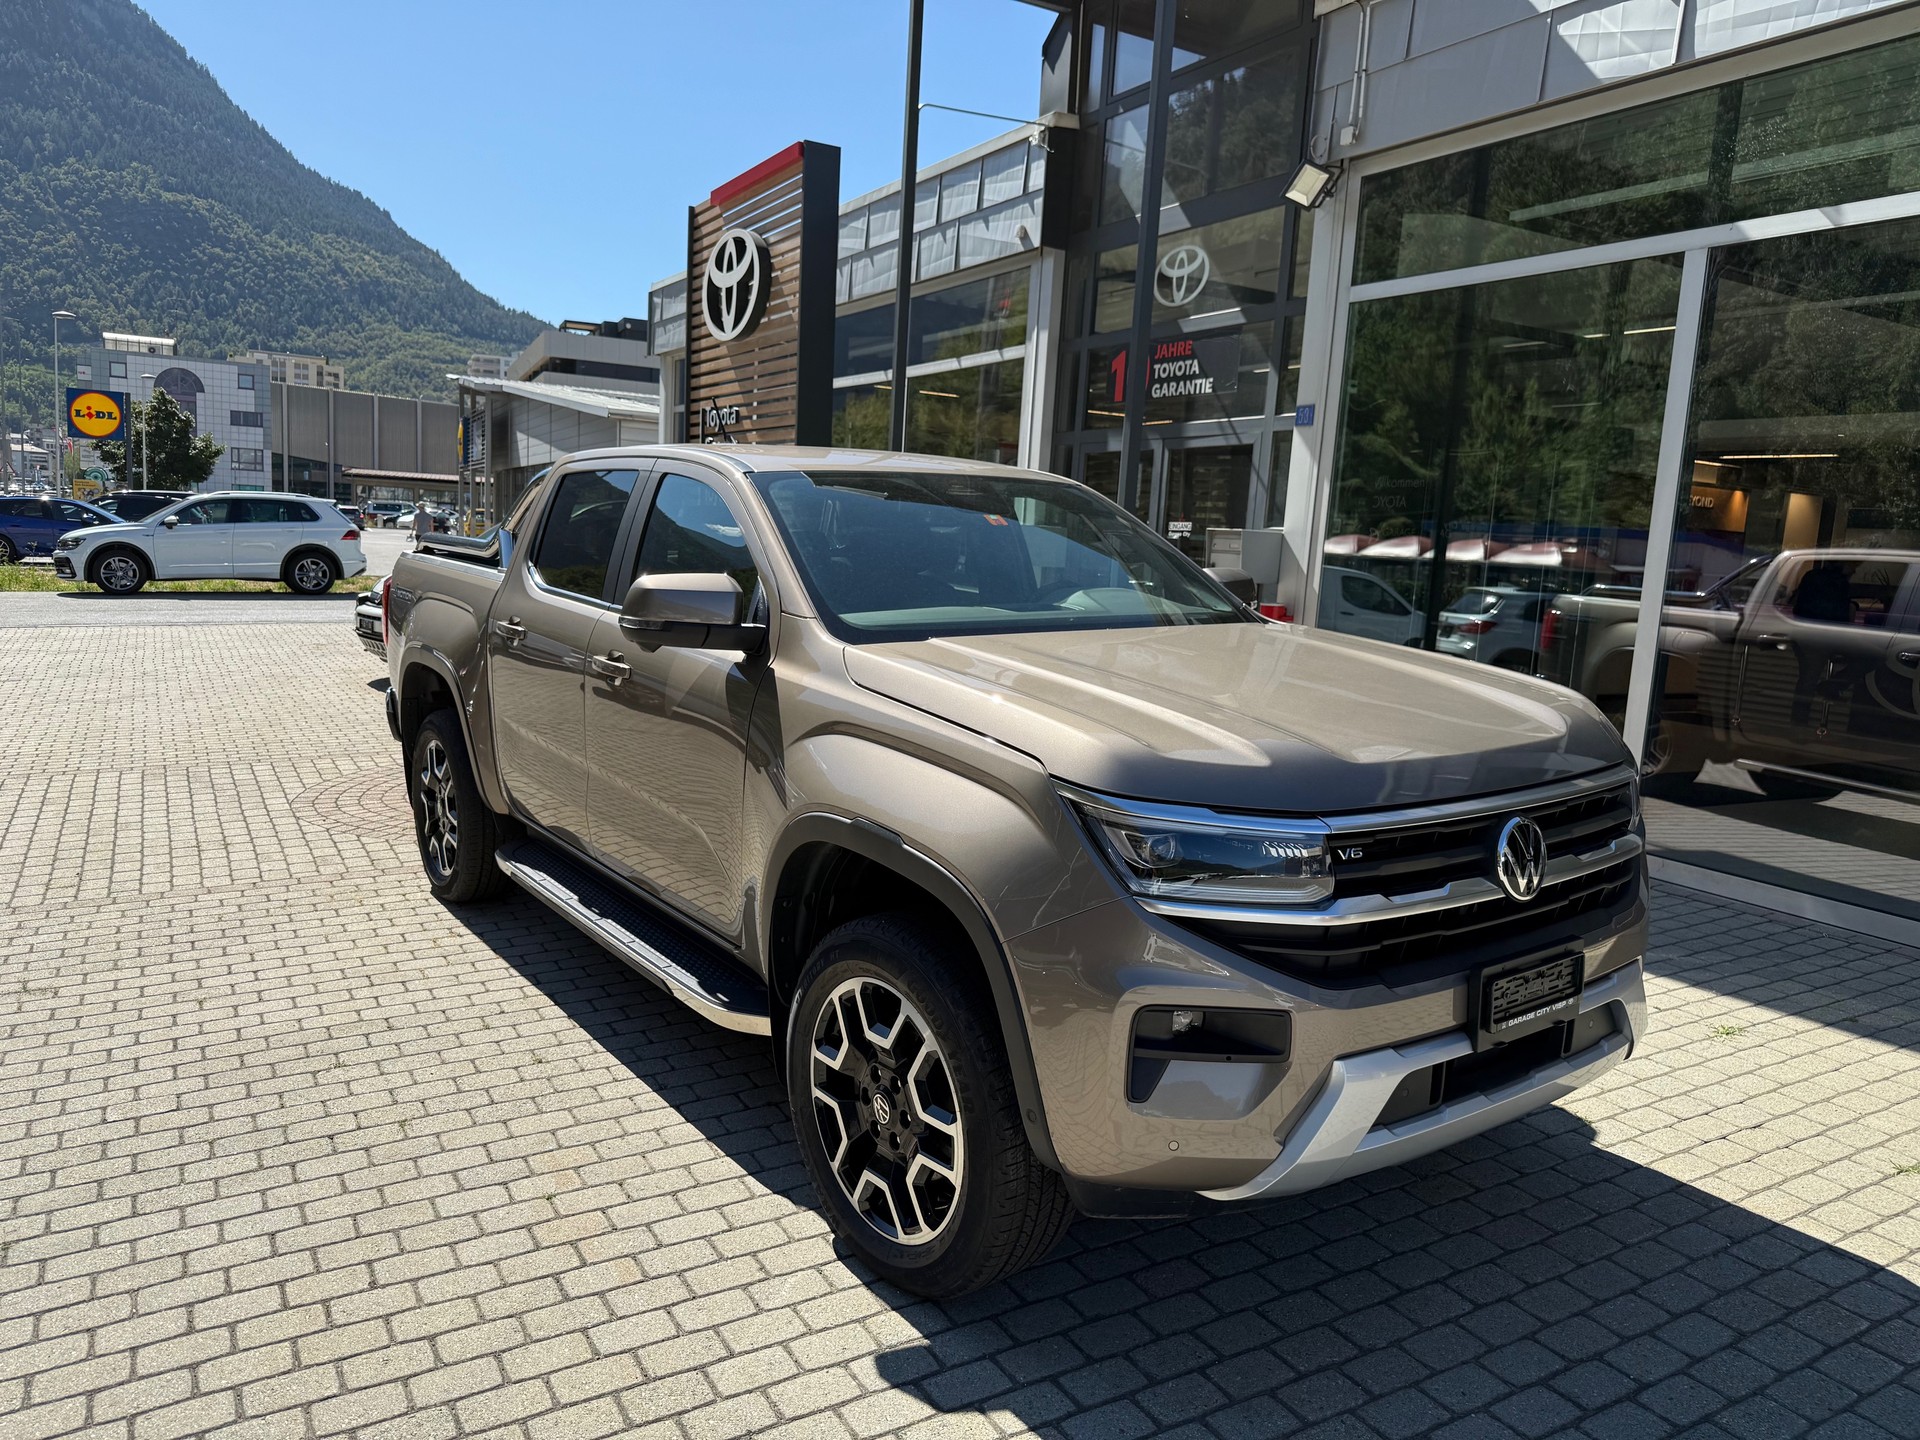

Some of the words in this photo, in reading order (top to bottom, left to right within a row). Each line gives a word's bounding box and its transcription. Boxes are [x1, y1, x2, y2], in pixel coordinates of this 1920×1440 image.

[1154, 340, 1193, 360] JAHRE
[1153, 358, 1200, 380] TOYOTA
[1151, 377, 1214, 399] GARANTIE
[706, 404, 739, 433] Toyota
[1689, 495, 1714, 508] YOND
[1337, 847, 1363, 860] V6
[1508, 1011, 1536, 1027] GARAGE
[1536, 1006, 1551, 1018] CITY
[1552, 1000, 1567, 1012] VISP
